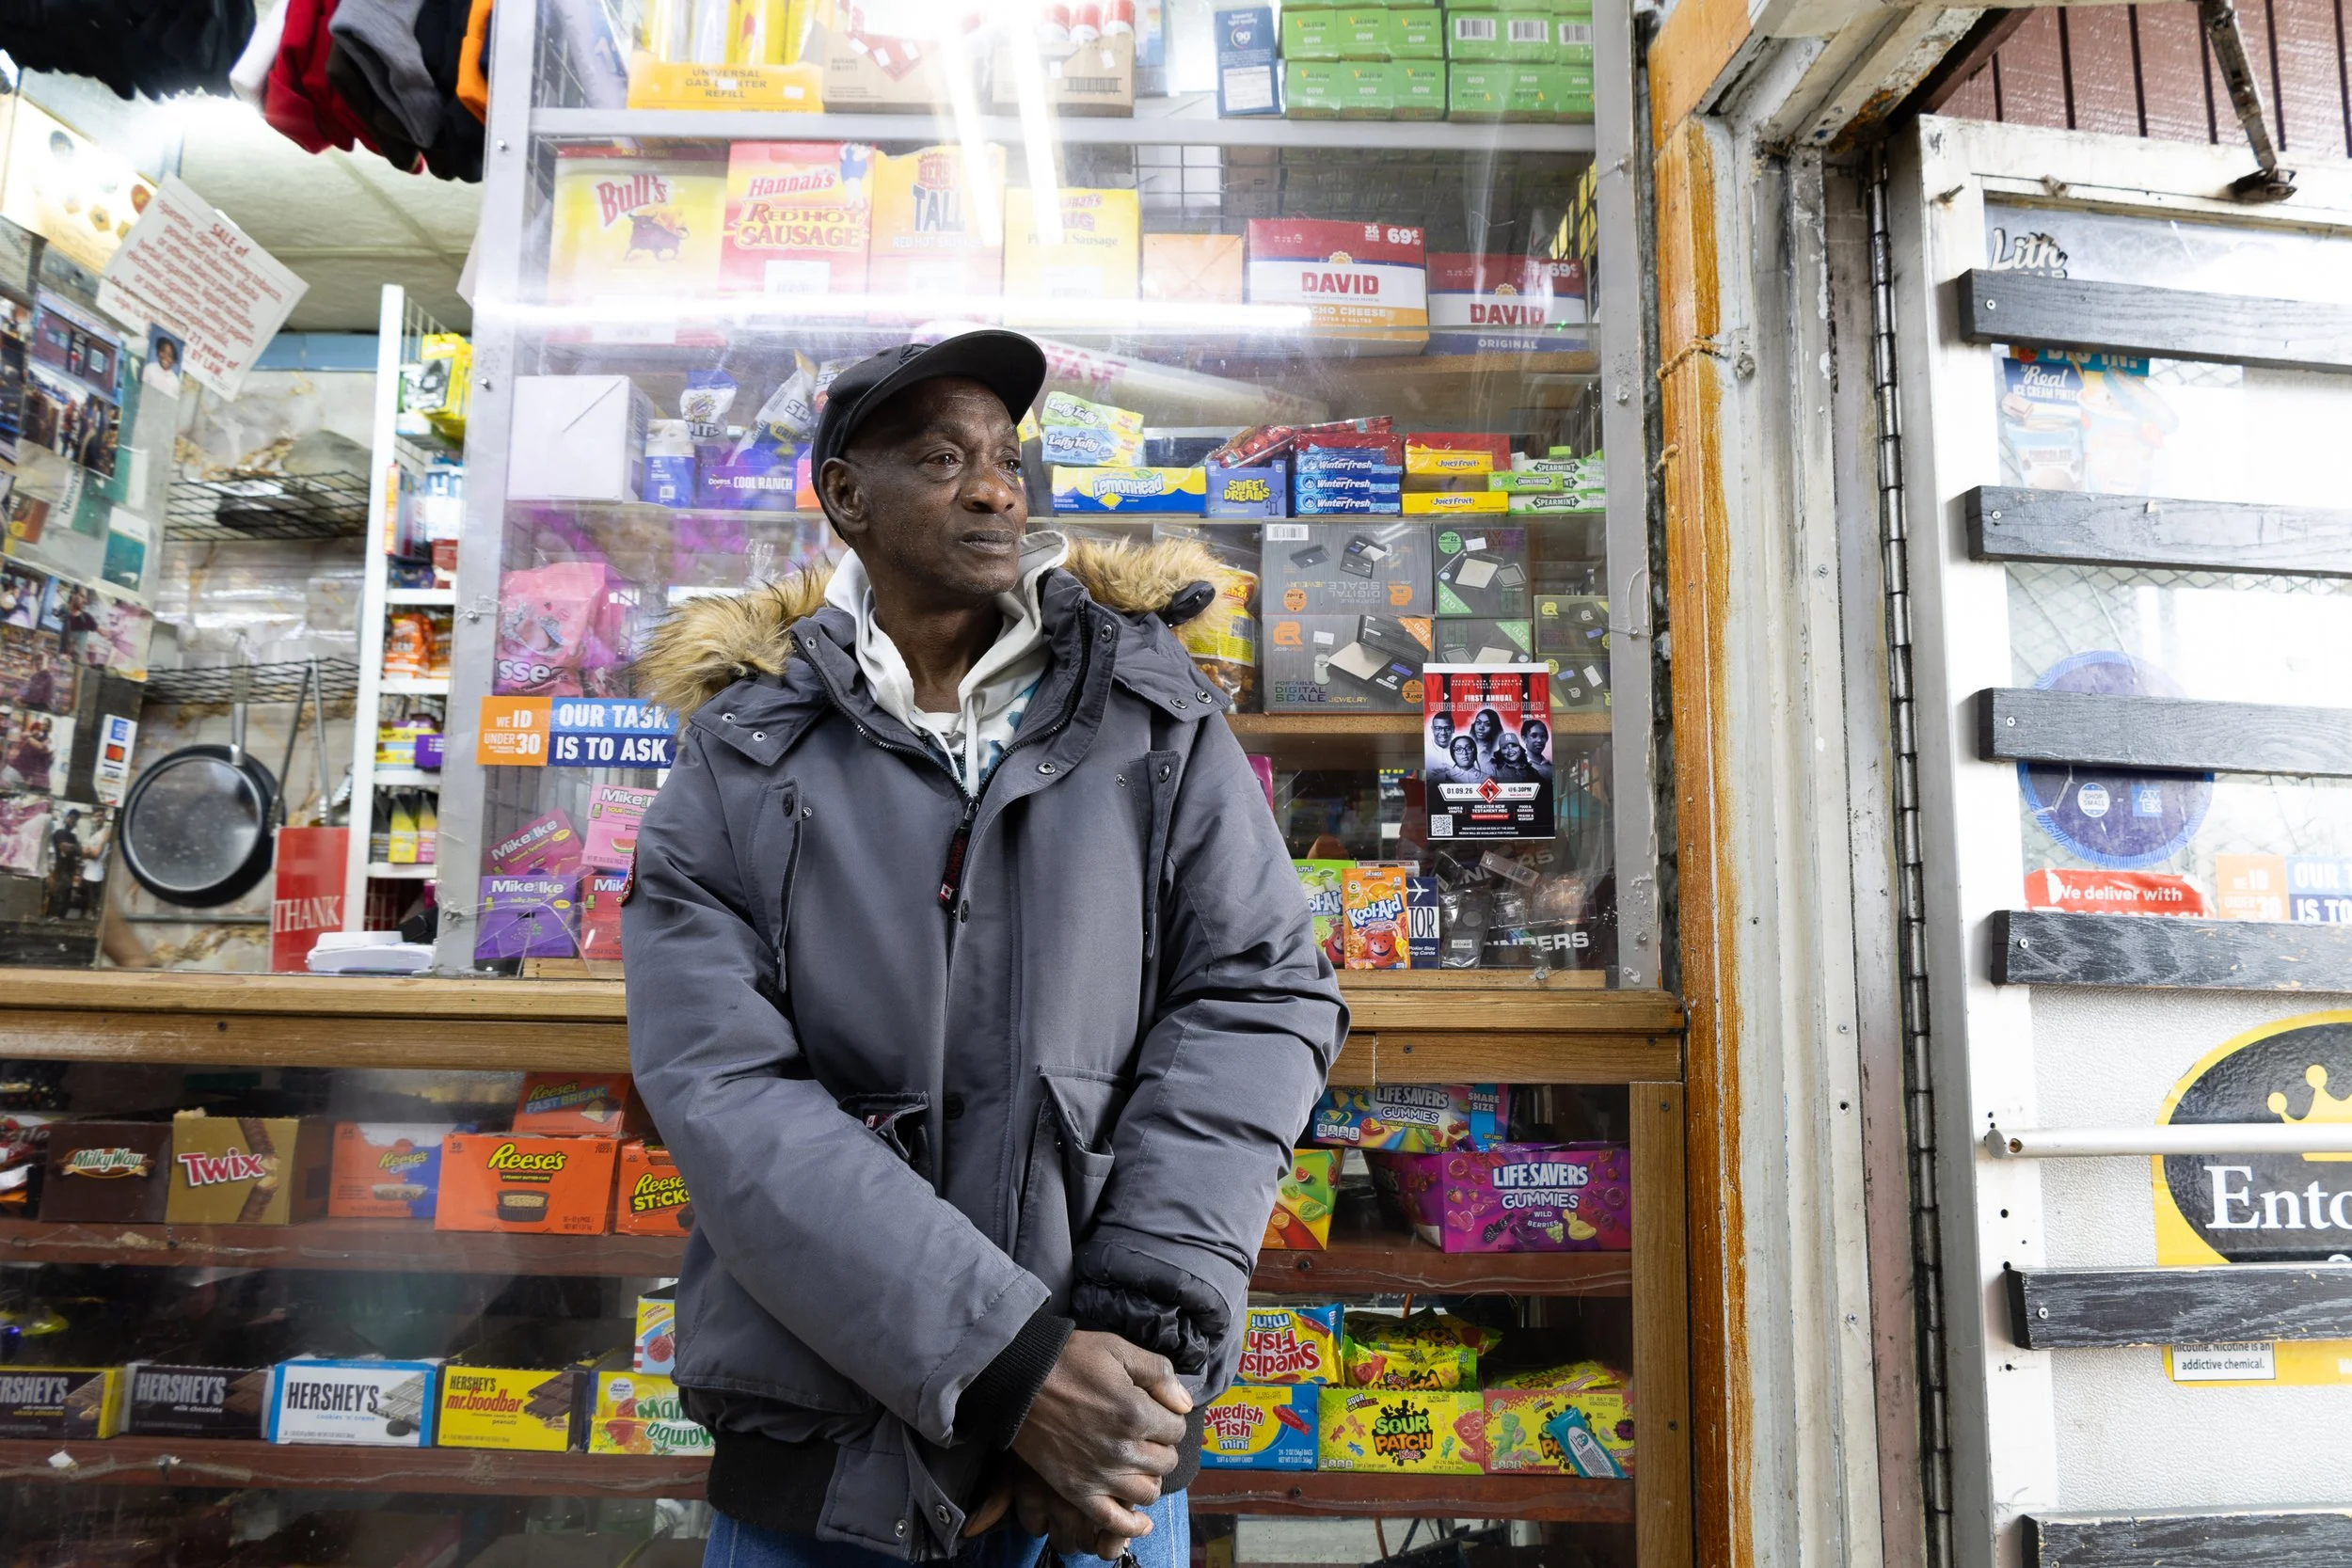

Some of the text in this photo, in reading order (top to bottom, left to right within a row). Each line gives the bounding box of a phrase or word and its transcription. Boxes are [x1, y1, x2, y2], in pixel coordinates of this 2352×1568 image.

[685, 79, 709, 87] GAS
[705, 89, 746, 99] REFILL
[748, 169, 836, 198] Hannah's
[596, 173, 667, 227] Bull's
[746, 202, 798, 224] RED
[210, 224, 237, 248] SALE
[740, 225, 859, 247] SAUSAGE
[1301, 272, 1379, 294] DAVID
[1340, 307, 1386, 317] CHEESE
[1470, 303, 1545, 325] DAVID
[189, 332, 227, 364] 21 years
[1478, 339, 1538, 350] ORIGINAL
[2024, 365, 2069, 388] Real
[2012, 384, 2026, 396] ICE
[2026, 385, 2053, 398] CREAM
[1049, 399, 1099, 424] Laffy Taffy
[1047, 435, 1100, 451] Laffy Taffy
[1318, 459, 1373, 473] Winterfresh
[1438, 459, 1478, 467] Juicy Fruit
[1536, 462, 1577, 472] SPEARMINT
[734, 476, 755, 489] COOL
[758, 476, 792, 490] RANCH
[1228, 479, 1265, 491] SWEET
[1317, 478, 1371, 489] Winterfresh
[1223, 487, 1270, 501] DREAMS
[1433, 497, 1474, 506] Juicy Fruit
[1535, 497, 1577, 507] SPEARMINT
[1317, 498, 1371, 509] Winterfresh
[1327, 581, 1381, 590] SCALE
[1275, 694, 1327, 703] SCALE
[1429, 702, 1545, 711] YOUNG ADULT WORSHIP NIGHT
[496, 710, 532, 728] WE ID
[559, 704, 670, 729] OUR TASK
[484, 733, 516, 745] UNDER
[516, 734, 541, 754] 30
[555, 736, 668, 763] IS TO ASK
[601, 788, 643, 805] Mike
[2139, 789, 2162, 802] AM
[2142, 800, 2162, 812] EX
[491, 819, 558, 862] Mike Ike
[2248, 868, 2269, 891] ID
[2293, 863, 2342, 889] OUR
[491, 879, 564, 894] Mike Ike
[2084, 884, 2138, 902] deliver
[2142, 885, 2183, 902] with
[274, 895, 342, 934] THANK
[2256, 895, 2282, 921] 30
[2296, 898, 2321, 922] IS
[525, 1086, 606, 1113] FAST BREAK
[529, 1083, 578, 1101] Reese's
[1468, 1092, 1500, 1103] SHARE
[1382, 1107, 1439, 1123] GUMMIES
[1472, 1102, 1495, 1112] SIZE
[377, 1150, 428, 1169] Reese's
[487, 1143, 568, 1170] Reese's
[634, 1173, 685, 1196] Reese
[1502, 1191, 1580, 1210] GUMMIES
[1527, 1219, 1560, 1228] BERRIES
[1251, 1313, 1290, 1327] mini
[1248, 1329, 1297, 1354] Fish
[2214, 1342, 2249, 1352] Nicotine
[2260, 1342, 2270, 1352] an
[2182, 1357, 2265, 1370] addictive chemical.
[135, 1372, 227, 1404] HERSHEY'S
[450, 1375, 497, 1392] HERSHEY'S
[286, 1382, 379, 1412] HERSHEY'S
[1346, 1393, 1365, 1407] SOUR
[1215, 1418, 1252, 1437] Fish
[1375, 1415, 1429, 1434] SOUR
[1218, 1438, 1249, 1450] mini
[1374, 1433, 1433, 1453] PATCH
[1399, 1449, 1422, 1459] Kids
